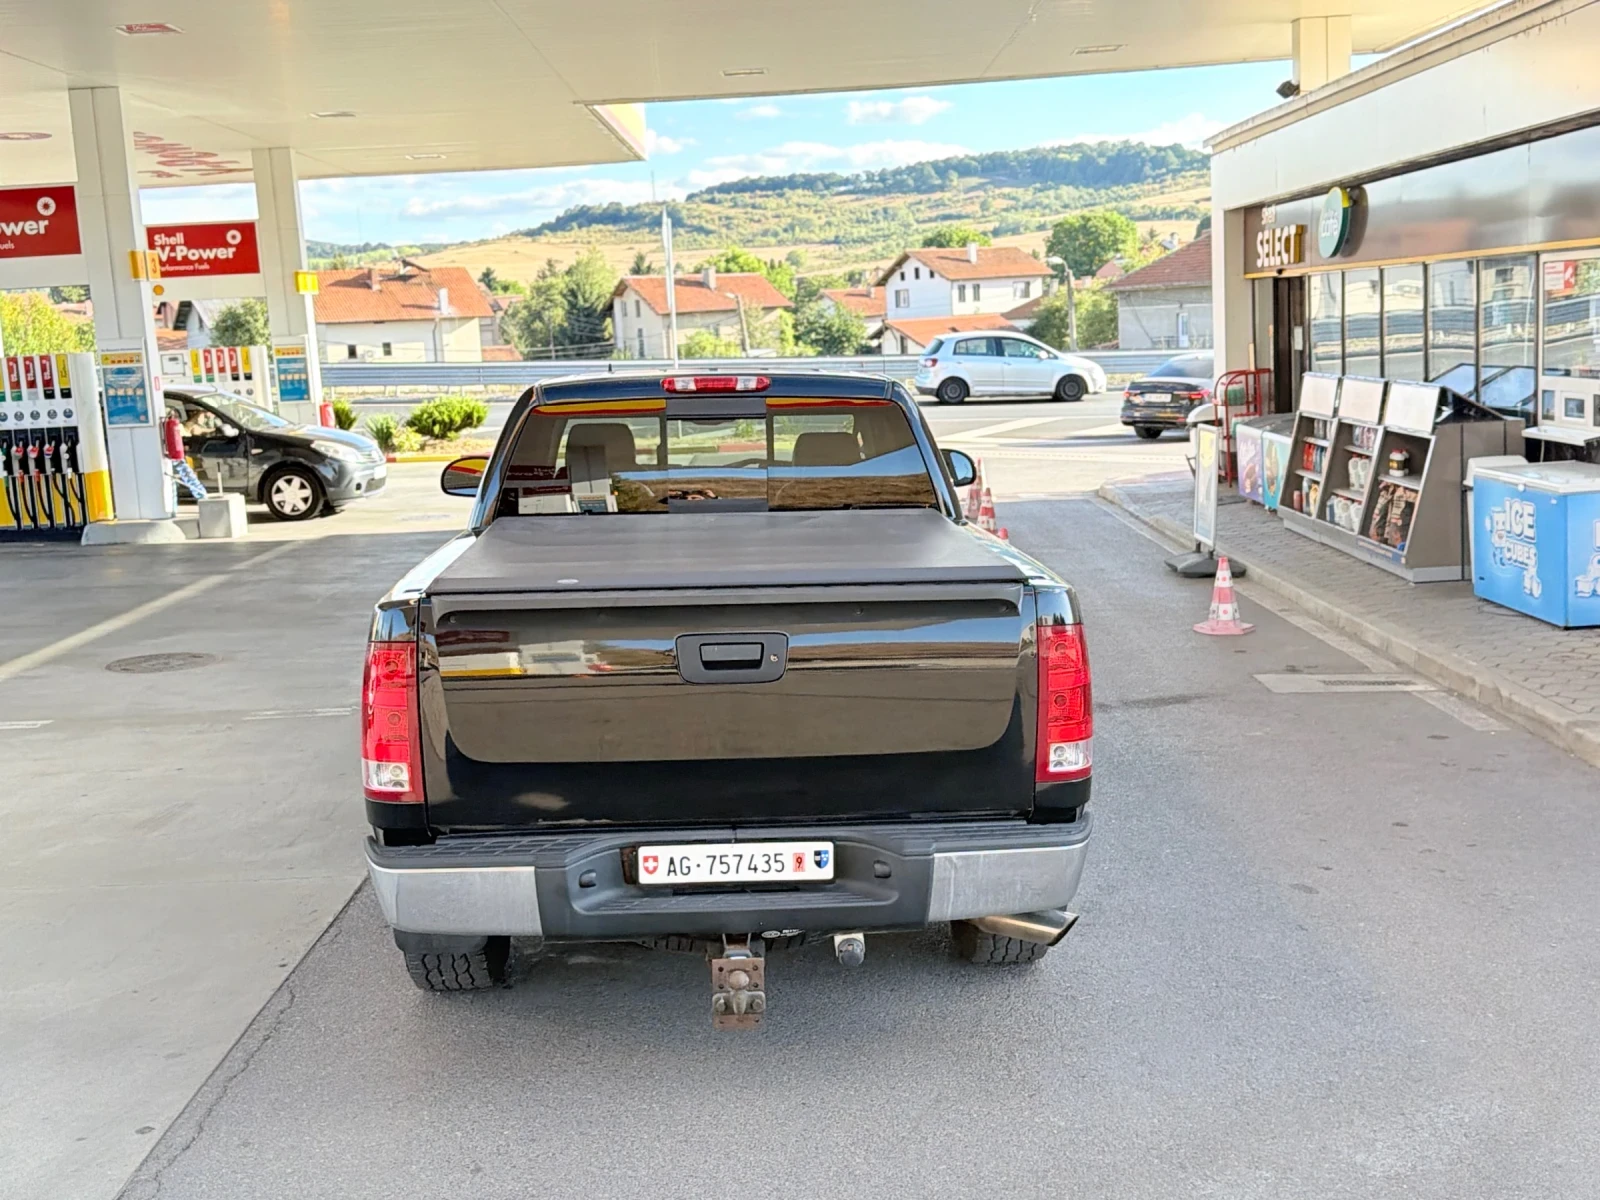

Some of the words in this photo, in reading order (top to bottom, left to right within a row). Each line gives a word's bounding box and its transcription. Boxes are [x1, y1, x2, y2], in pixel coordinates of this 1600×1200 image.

[0, 219, 49, 237] wer
[0, 240, 15, 250] uels
[153, 232, 185, 246] Shell
[1256, 223, 1297, 268] SELECT
[156, 246, 237, 262] V-Power
[160, 263, 194, 272] erformance
[1504, 498, 1537, 542] ICE
[1504, 539, 1537, 568] CUBES
